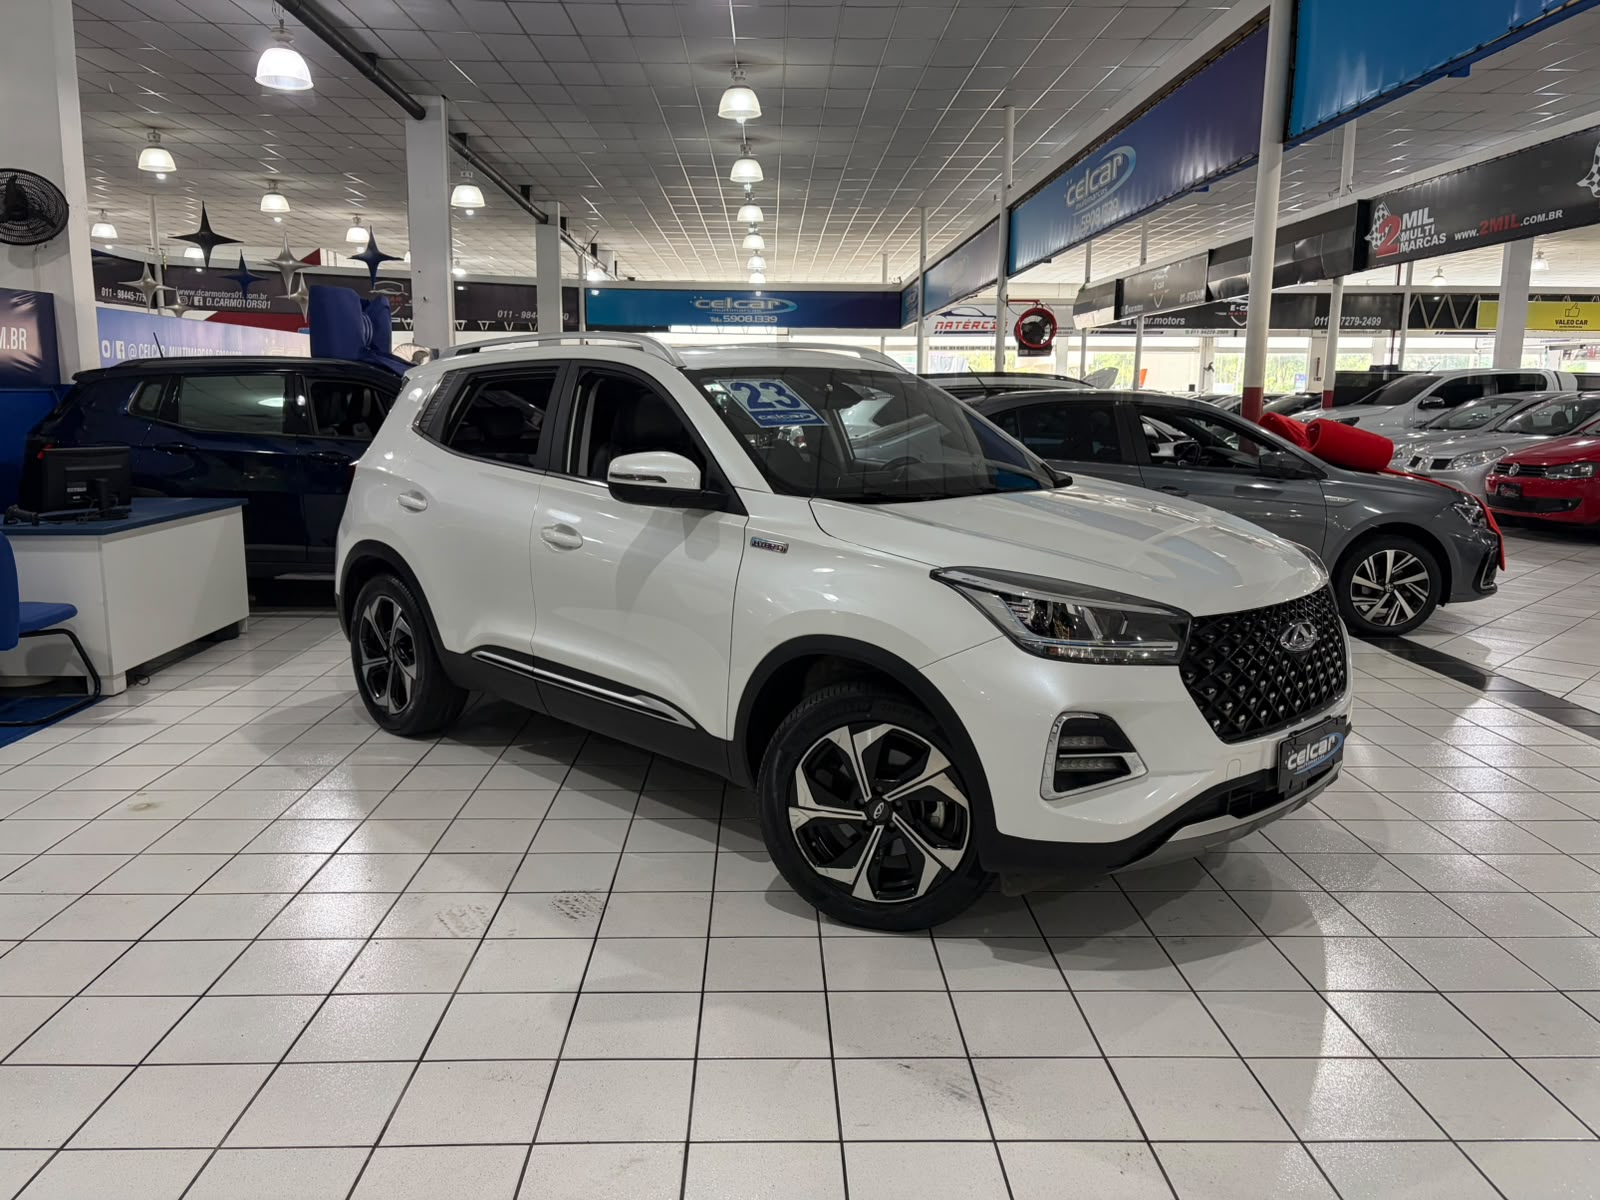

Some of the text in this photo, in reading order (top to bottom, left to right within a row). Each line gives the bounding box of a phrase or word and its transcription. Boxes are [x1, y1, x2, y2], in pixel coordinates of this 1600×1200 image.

[1066, 155, 1123, 207] celcar
[1376, 207, 1434, 258] 2 MIL
[1401, 226, 1435, 243] MULTI
[1454, 209, 1563, 241] www.2MIL.COM.BR
[1400, 232, 1447, 253] MARCAS
[101, 286, 113, 297] 011
[694, 297, 781, 309] celcar
[497, 310, 513, 318] 011
[1314, 316, 1329, 326] 011
[730, 382, 801, 410] 23
[1288, 735, 1336, 770] celcar
